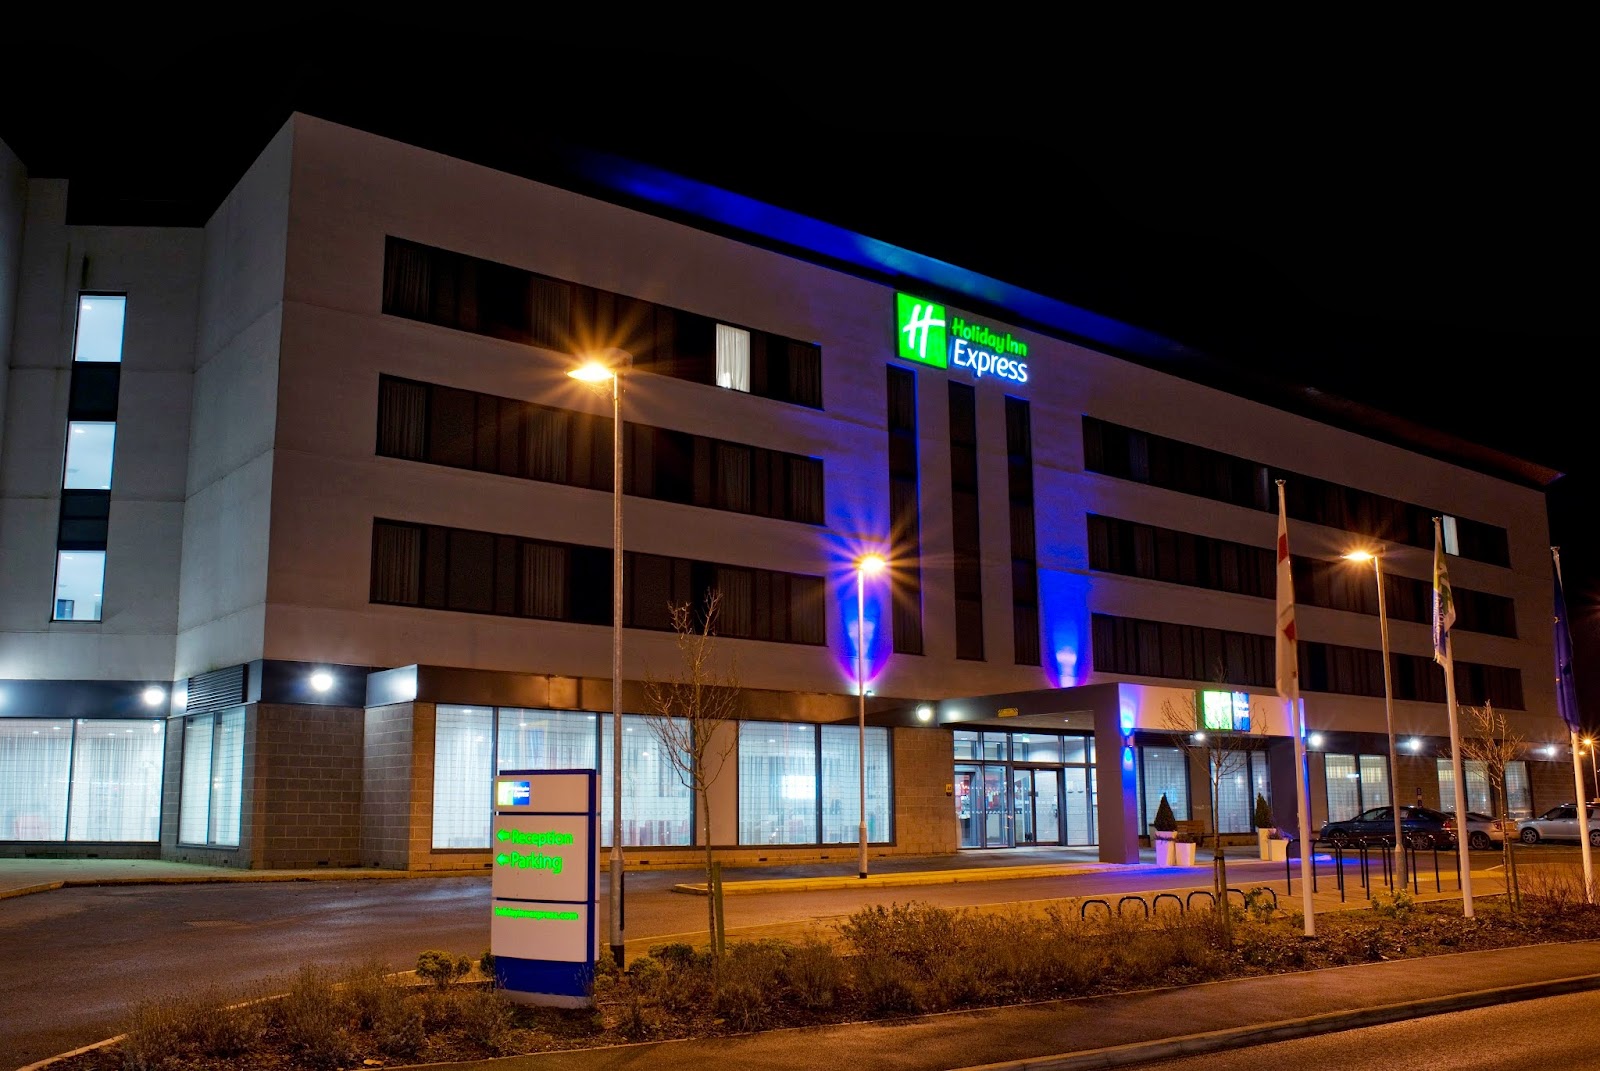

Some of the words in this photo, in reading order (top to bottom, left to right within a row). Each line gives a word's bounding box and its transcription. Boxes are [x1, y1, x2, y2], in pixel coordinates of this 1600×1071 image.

[951, 318, 1004, 354] Holiday
[1006, 333, 1028, 357] Inn
[954, 339, 1028, 383] Express
[511, 829, 573, 847] Reception
[510, 851, 563, 874] Parking
